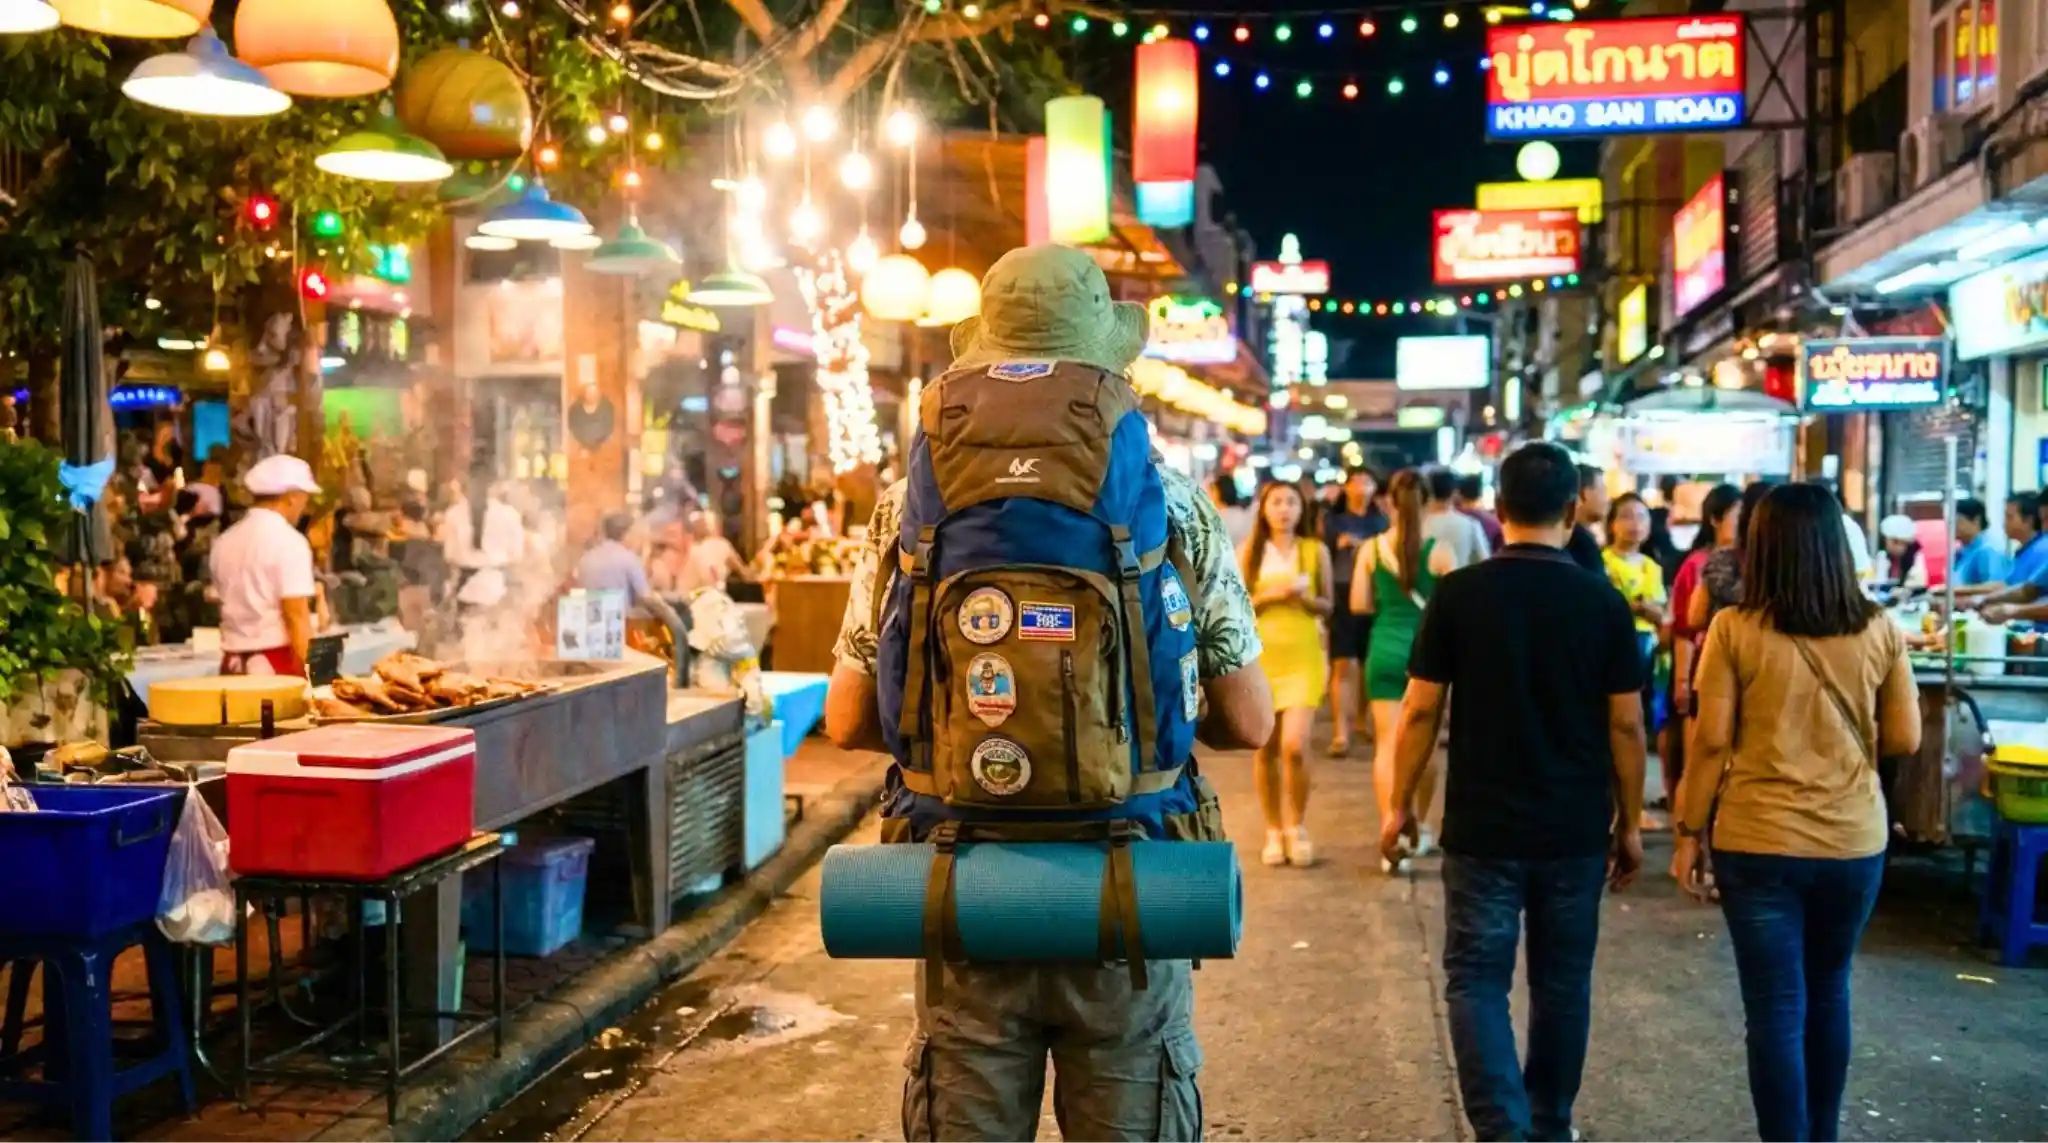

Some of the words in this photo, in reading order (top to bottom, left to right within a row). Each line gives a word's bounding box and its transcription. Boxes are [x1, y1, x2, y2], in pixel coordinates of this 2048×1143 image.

[1496, 104, 1576, 130] KHAO
[1585, 101, 1645, 127] SAN
[1655, 97, 1736, 124] ROAD
